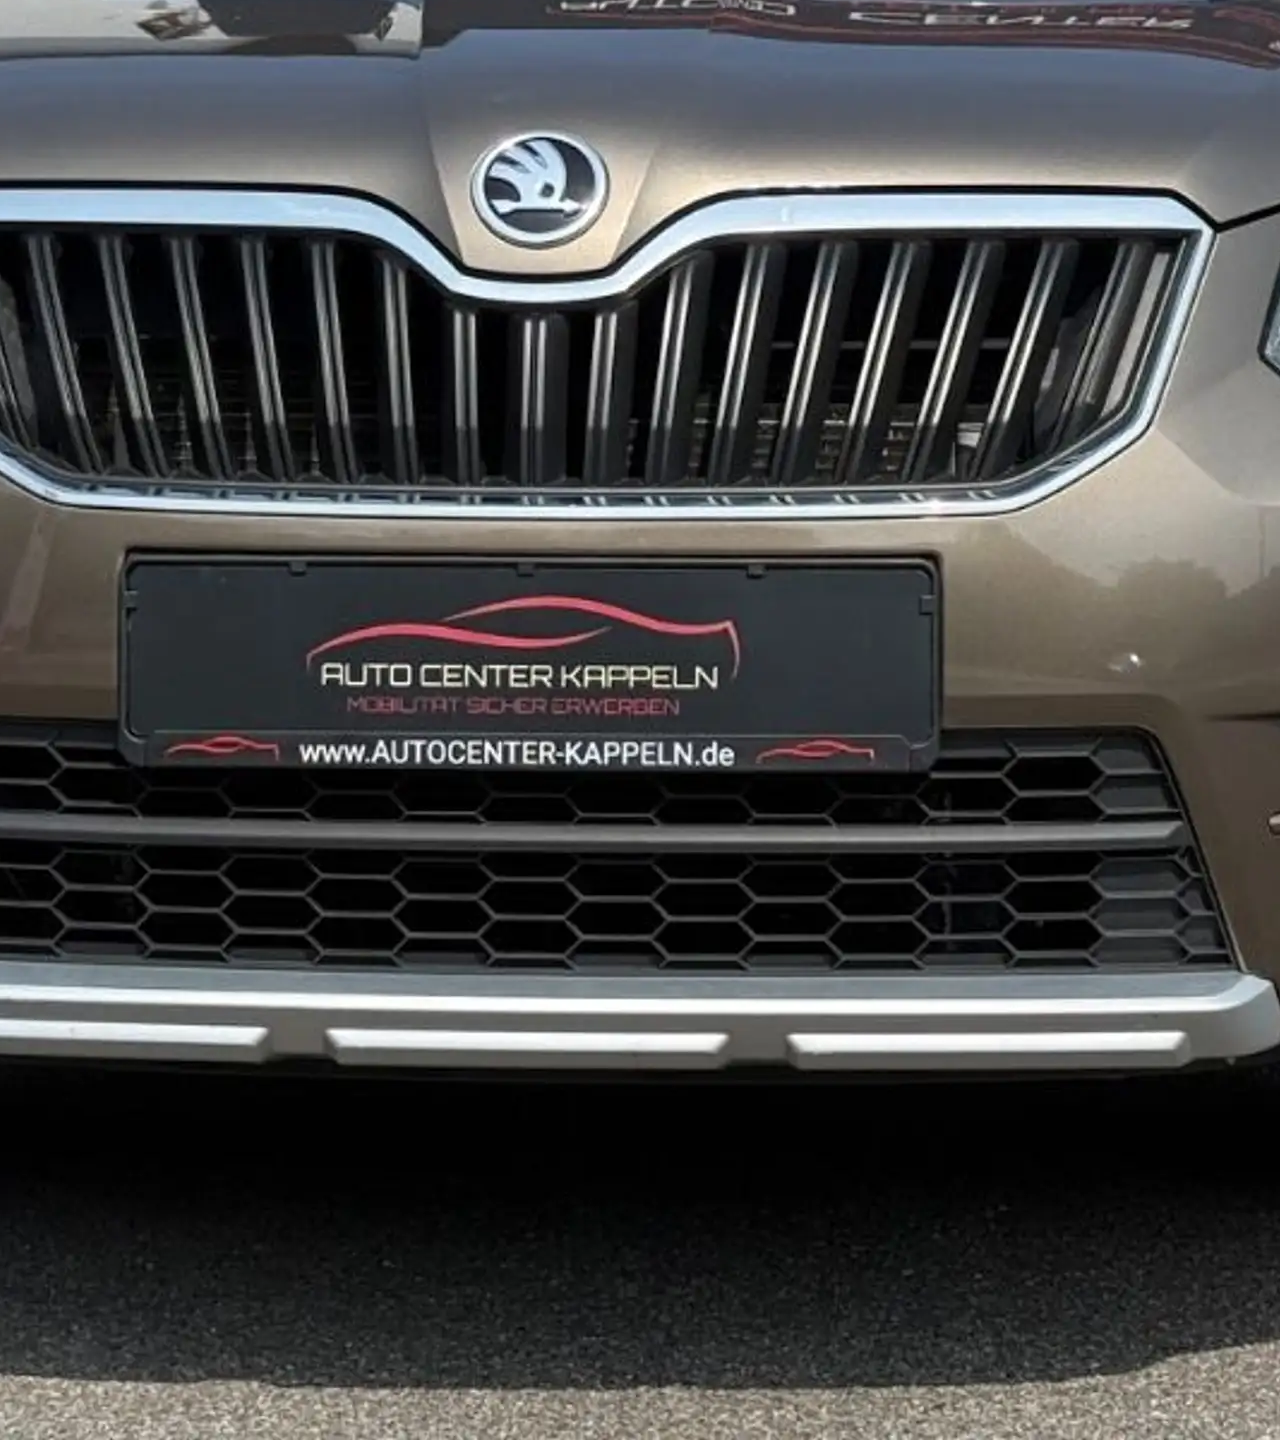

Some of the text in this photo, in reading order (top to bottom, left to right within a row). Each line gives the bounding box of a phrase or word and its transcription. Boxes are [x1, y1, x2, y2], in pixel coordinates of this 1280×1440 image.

[321, 662, 719, 689] AUTO CENTER KAPPELN
[299, 739, 735, 767] www.AUTOCENTER-KAPPELN.de
